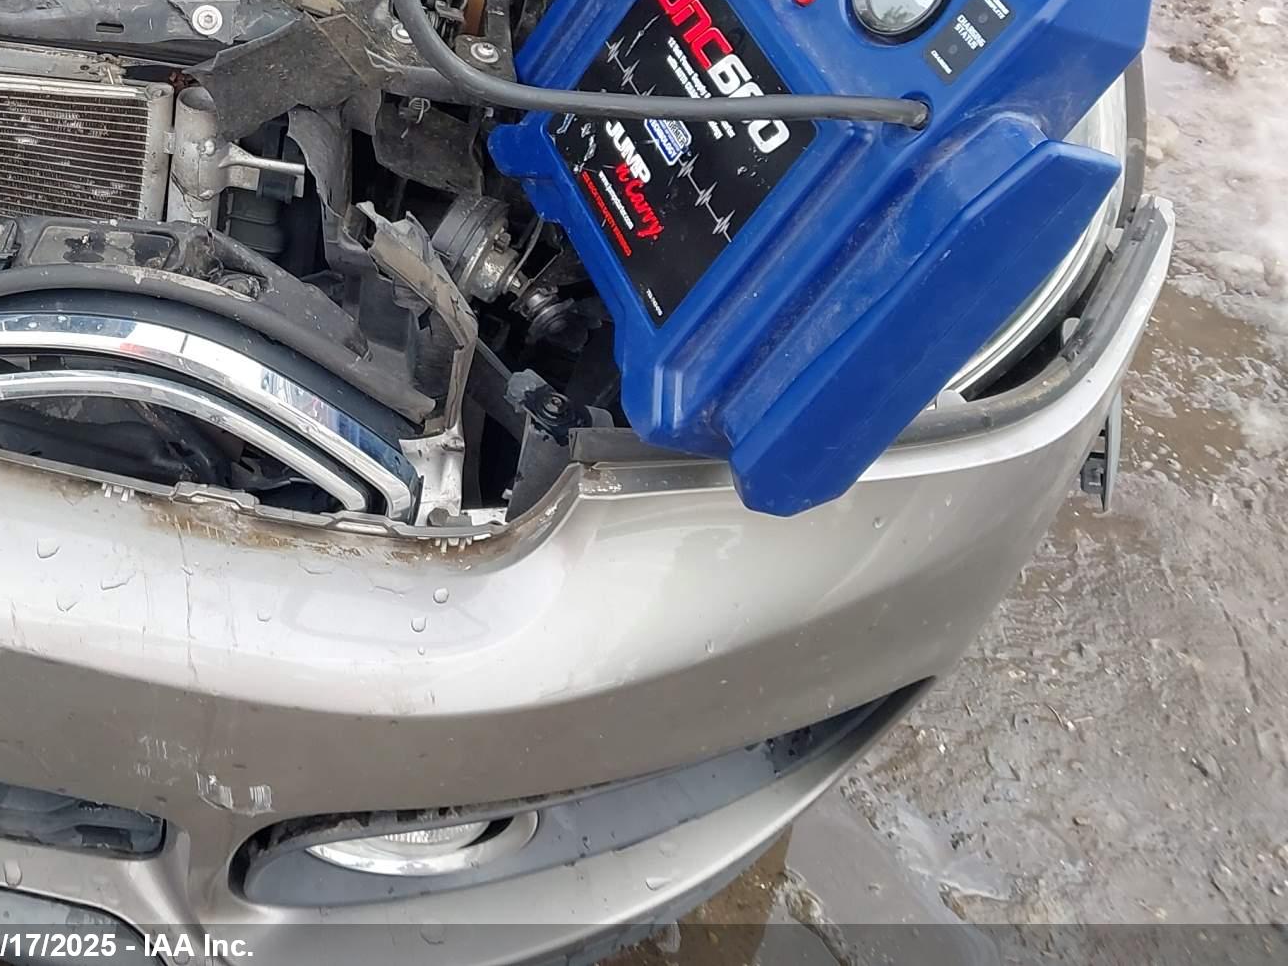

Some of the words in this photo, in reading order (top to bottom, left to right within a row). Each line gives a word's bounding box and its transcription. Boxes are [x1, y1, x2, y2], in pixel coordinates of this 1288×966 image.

[954, 23, 978, 49] STATUS
[957, 15, 985, 47] CHARGING
[667, 36, 677, 48] 12
[679, 55, 694, 76] Power
[691, 73, 707, 96] Supply
[606, 121, 651, 183] JUMP
[624, 179, 664, 237] Carry
